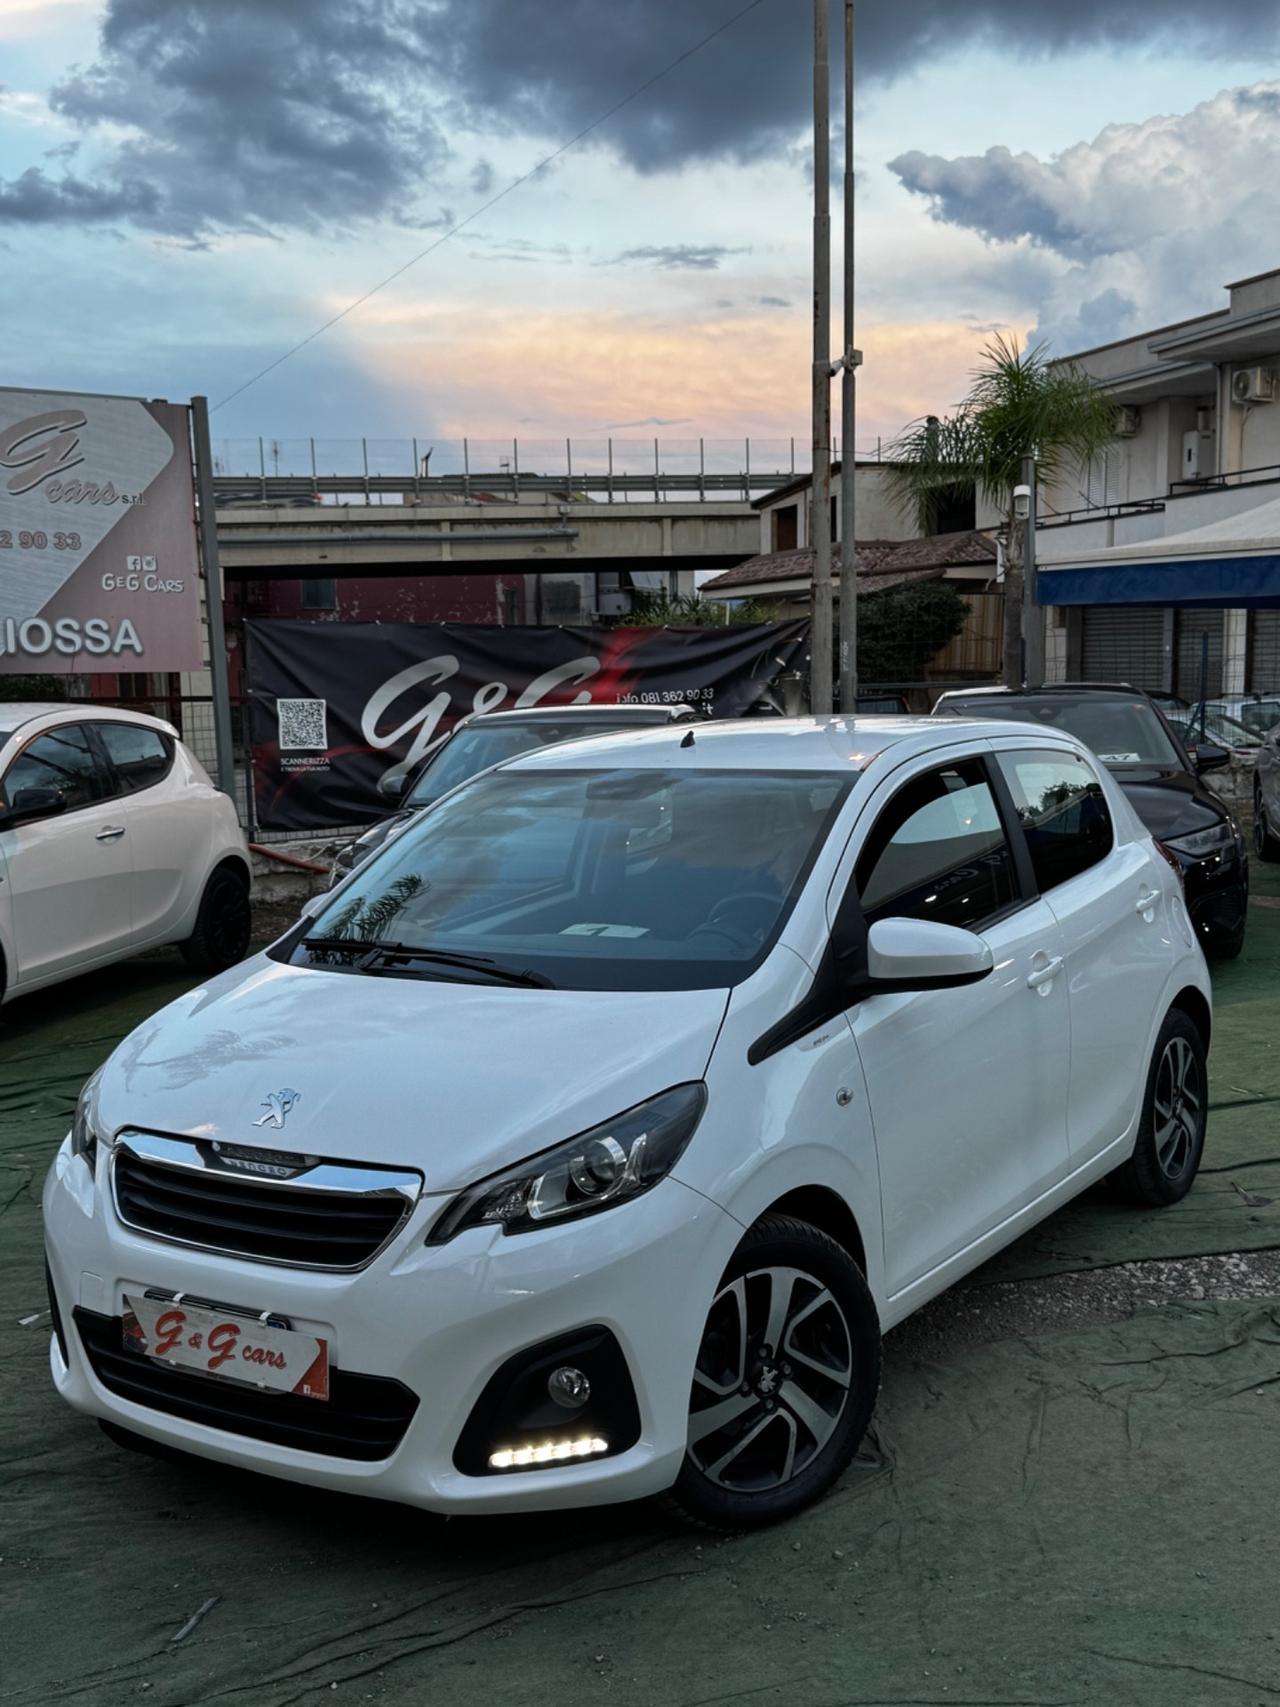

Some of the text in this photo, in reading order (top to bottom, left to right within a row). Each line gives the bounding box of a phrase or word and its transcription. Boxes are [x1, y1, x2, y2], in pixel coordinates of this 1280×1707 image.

[19, 531, 48, 549] 90
[54, 532, 81, 550] 33
[0, 617, 143, 654] IOSSA
[641, 692, 660, 703] 081
[662, 691, 684, 702] 362
[701, 688, 714, 699] 33
[155, 1310, 288, 1370] G & G cars
